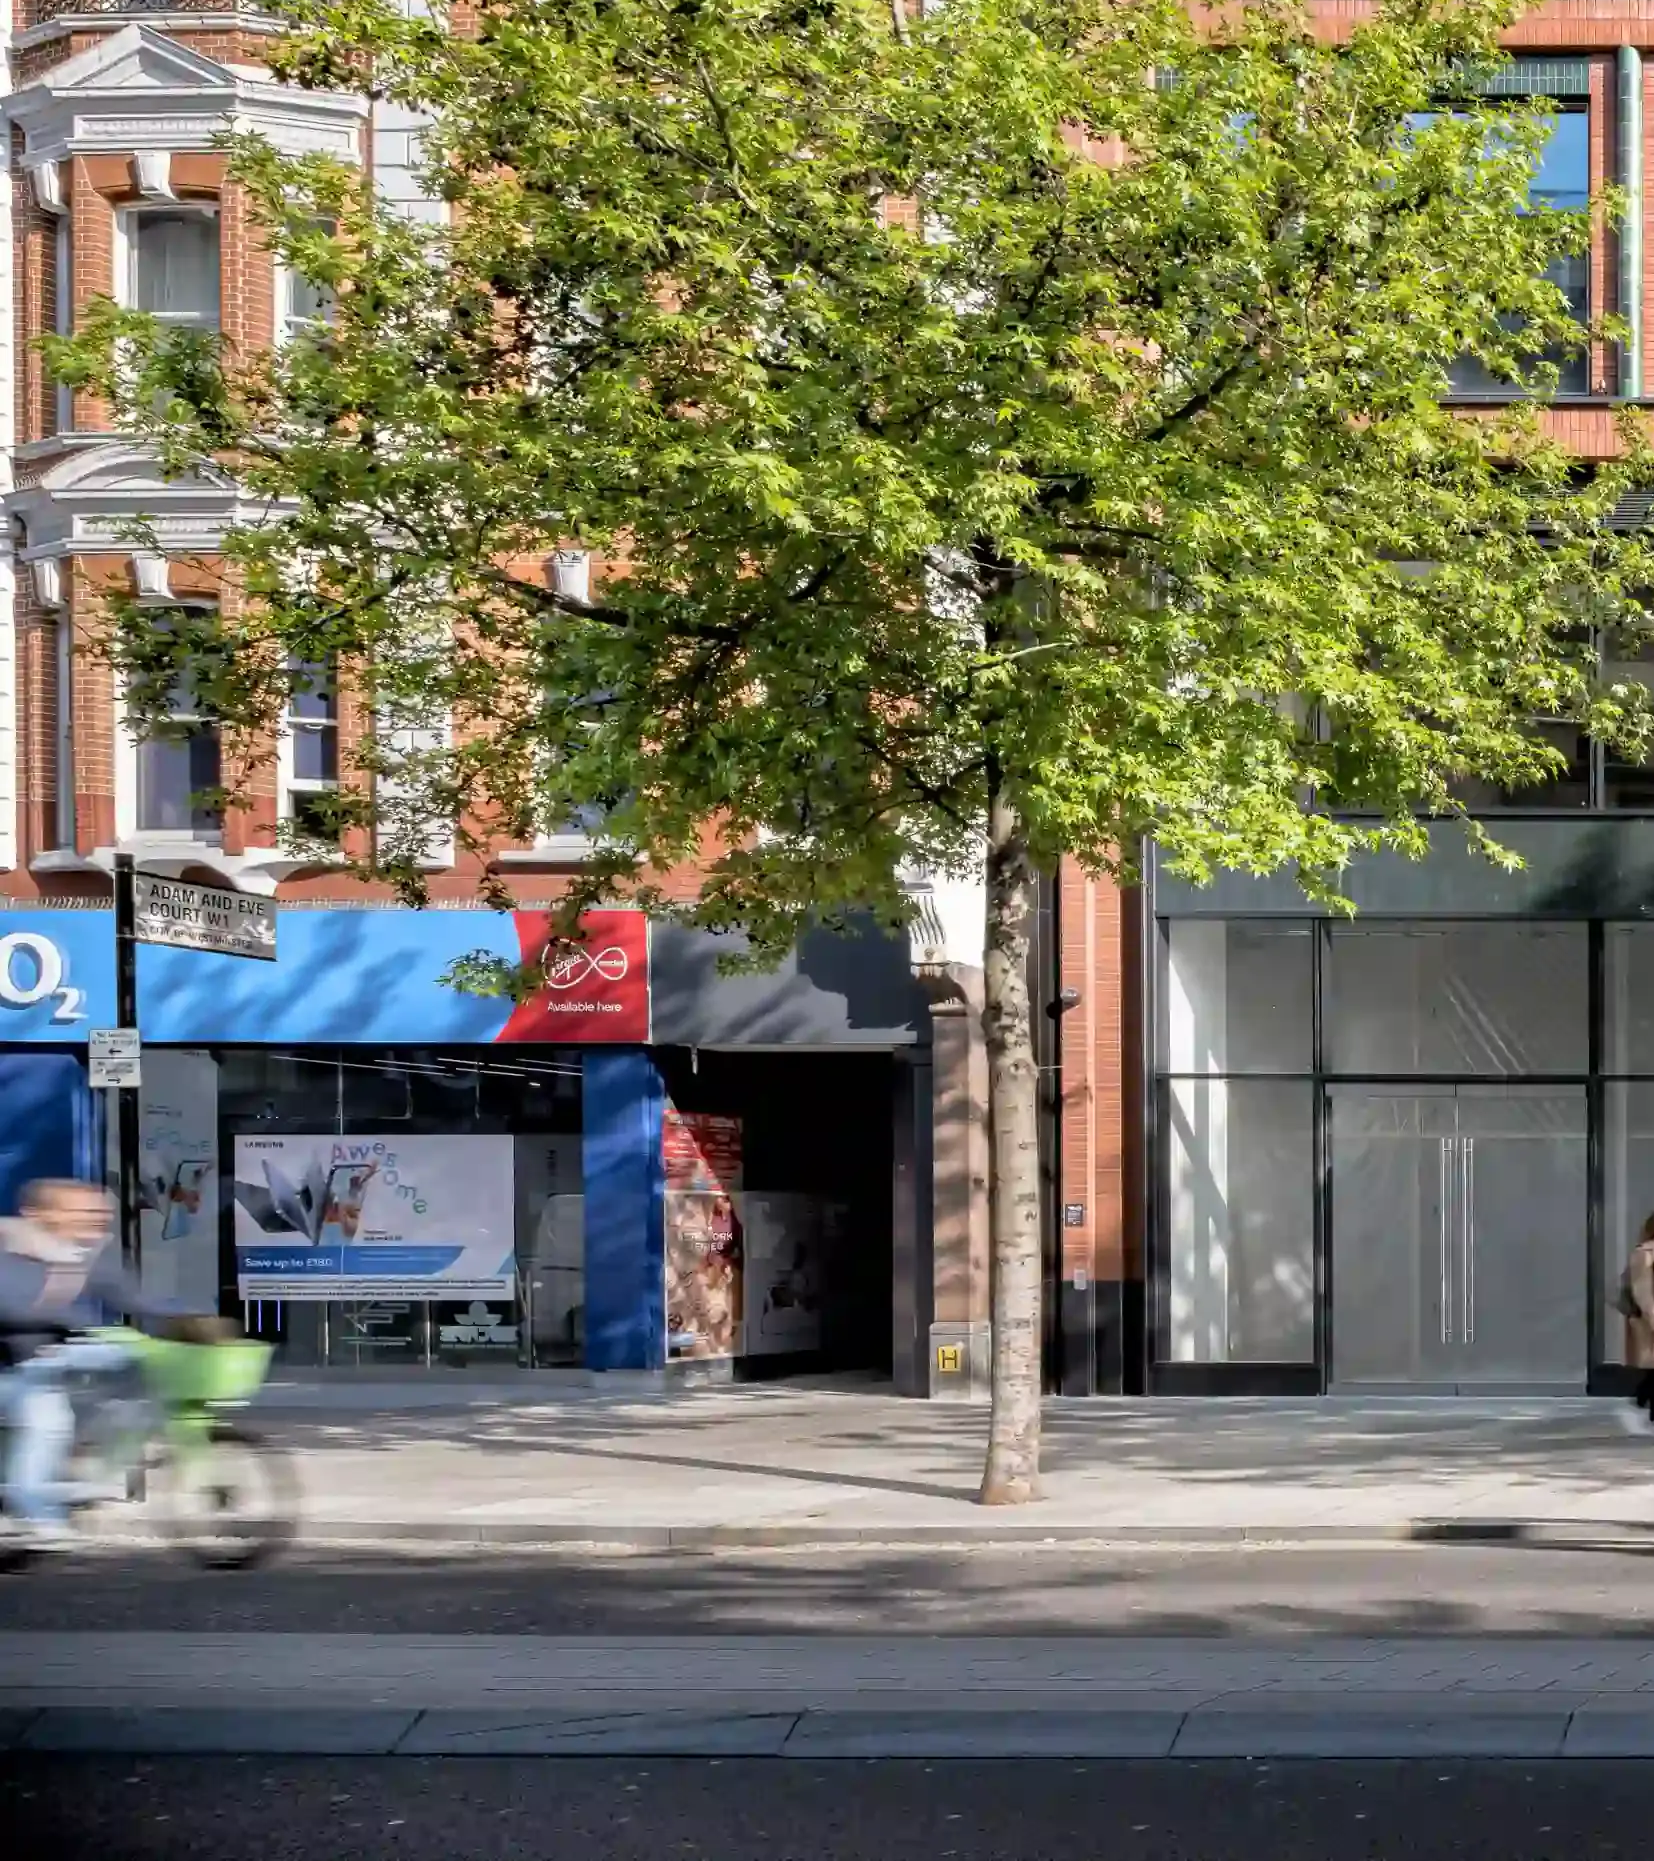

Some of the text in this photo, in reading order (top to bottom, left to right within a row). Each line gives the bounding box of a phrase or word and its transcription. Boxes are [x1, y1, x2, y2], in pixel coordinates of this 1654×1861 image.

[150, 884, 265, 916] ADAM AND EVE
[150, 902, 229, 928] COURT W1
[547, 1001, 623, 1012] Available here
[245, 1258, 271, 1268] Save
[273, 1259, 289, 1269] up
[291, 1258, 304, 1268] to
[941, 1349, 957, 1369] H
